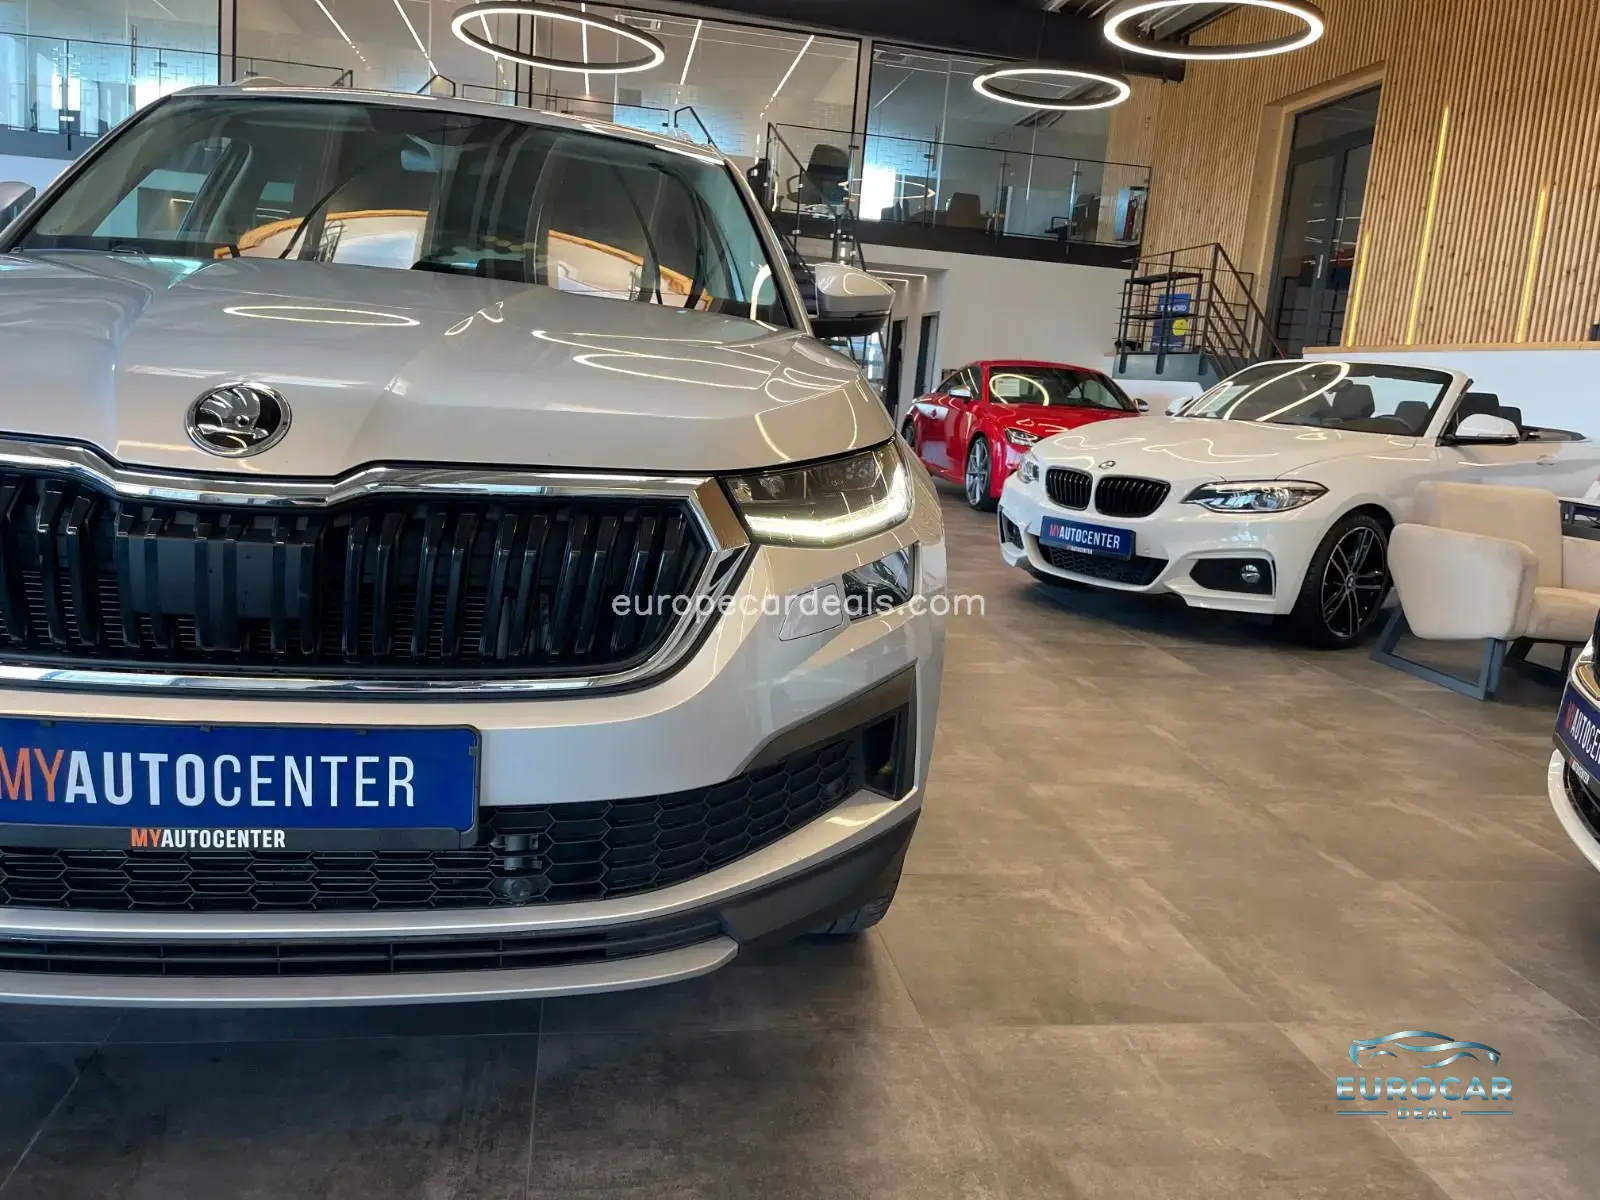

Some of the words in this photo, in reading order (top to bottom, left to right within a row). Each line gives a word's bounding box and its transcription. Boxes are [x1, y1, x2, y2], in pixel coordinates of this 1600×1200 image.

[1049, 523, 1120, 549] MYAUTOCENTER
[0, 746, 415, 808] MYAUTOCENTER
[130, 828, 286, 849] MYAUTOCENTER
